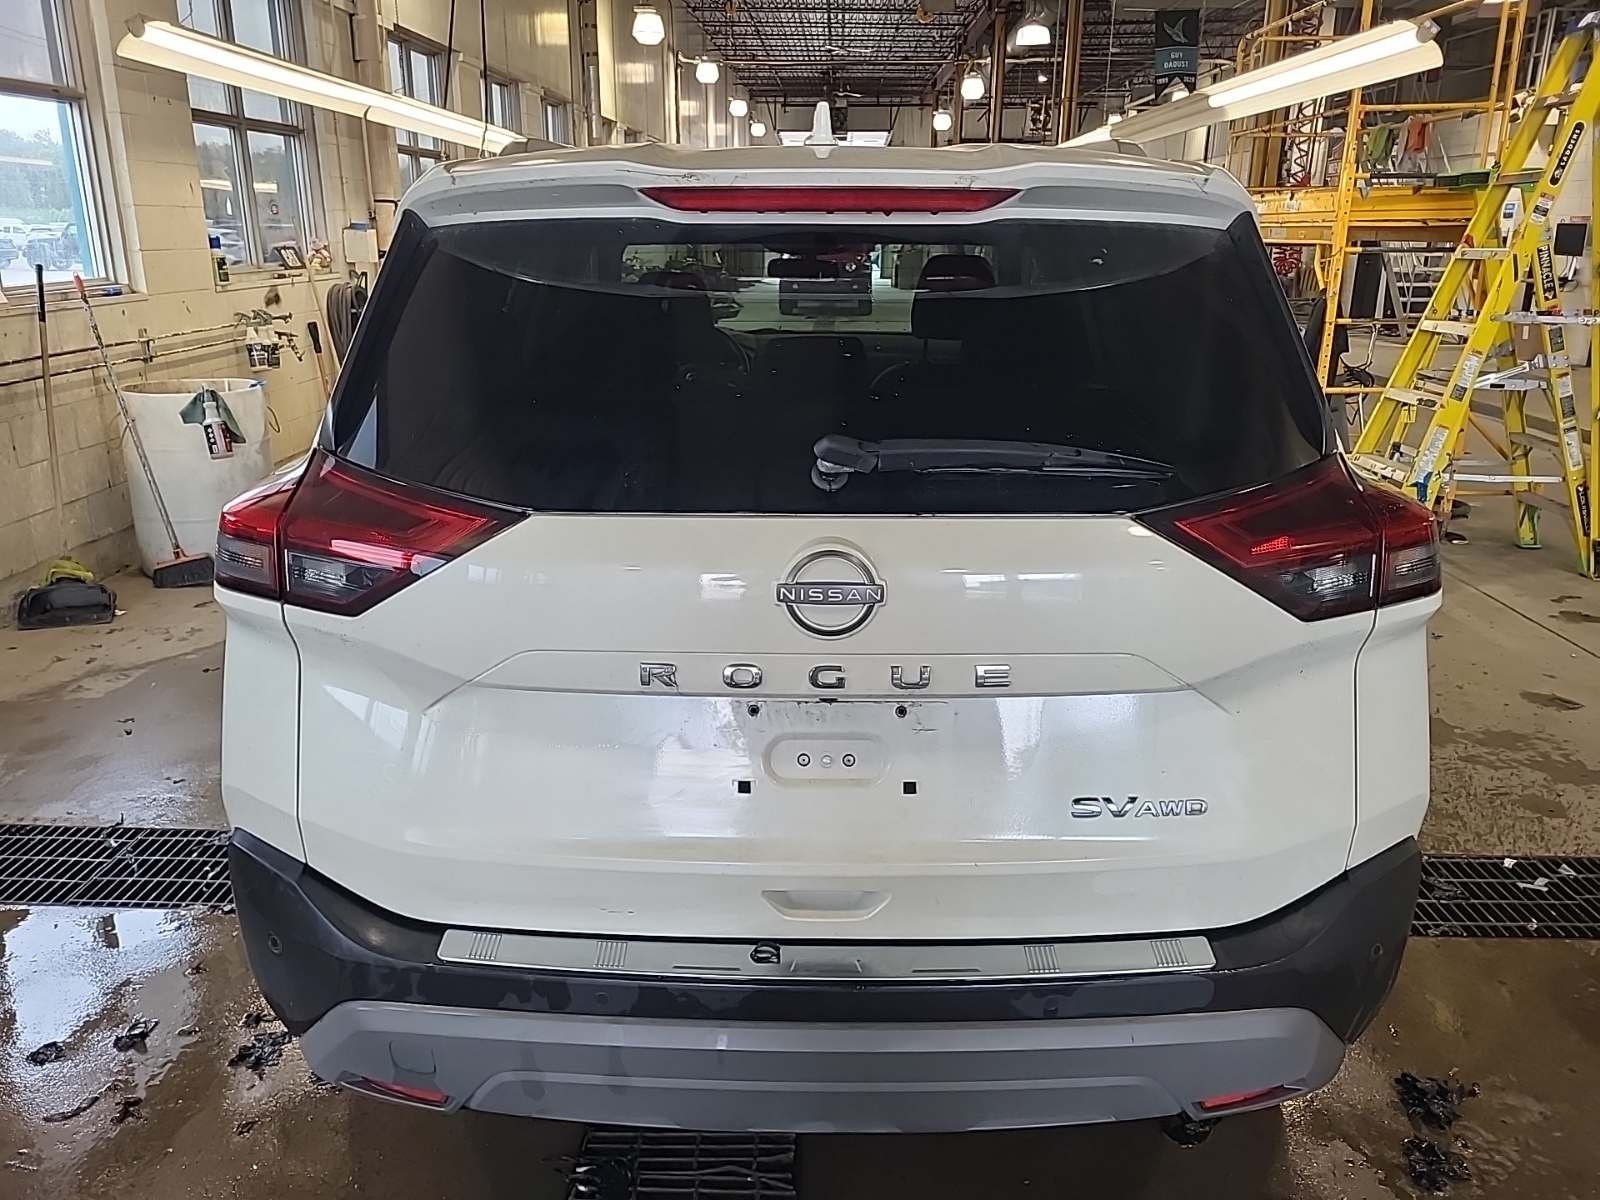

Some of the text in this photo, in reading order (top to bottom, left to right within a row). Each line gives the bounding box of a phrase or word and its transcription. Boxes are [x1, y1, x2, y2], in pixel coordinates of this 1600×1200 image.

[1560, 128, 1581, 166] LADDERS
[1538, 244, 1554, 290] PINNACLE
[779, 586, 882, 601] NISSAN
[639, 662, 1012, 689] ROGUE
